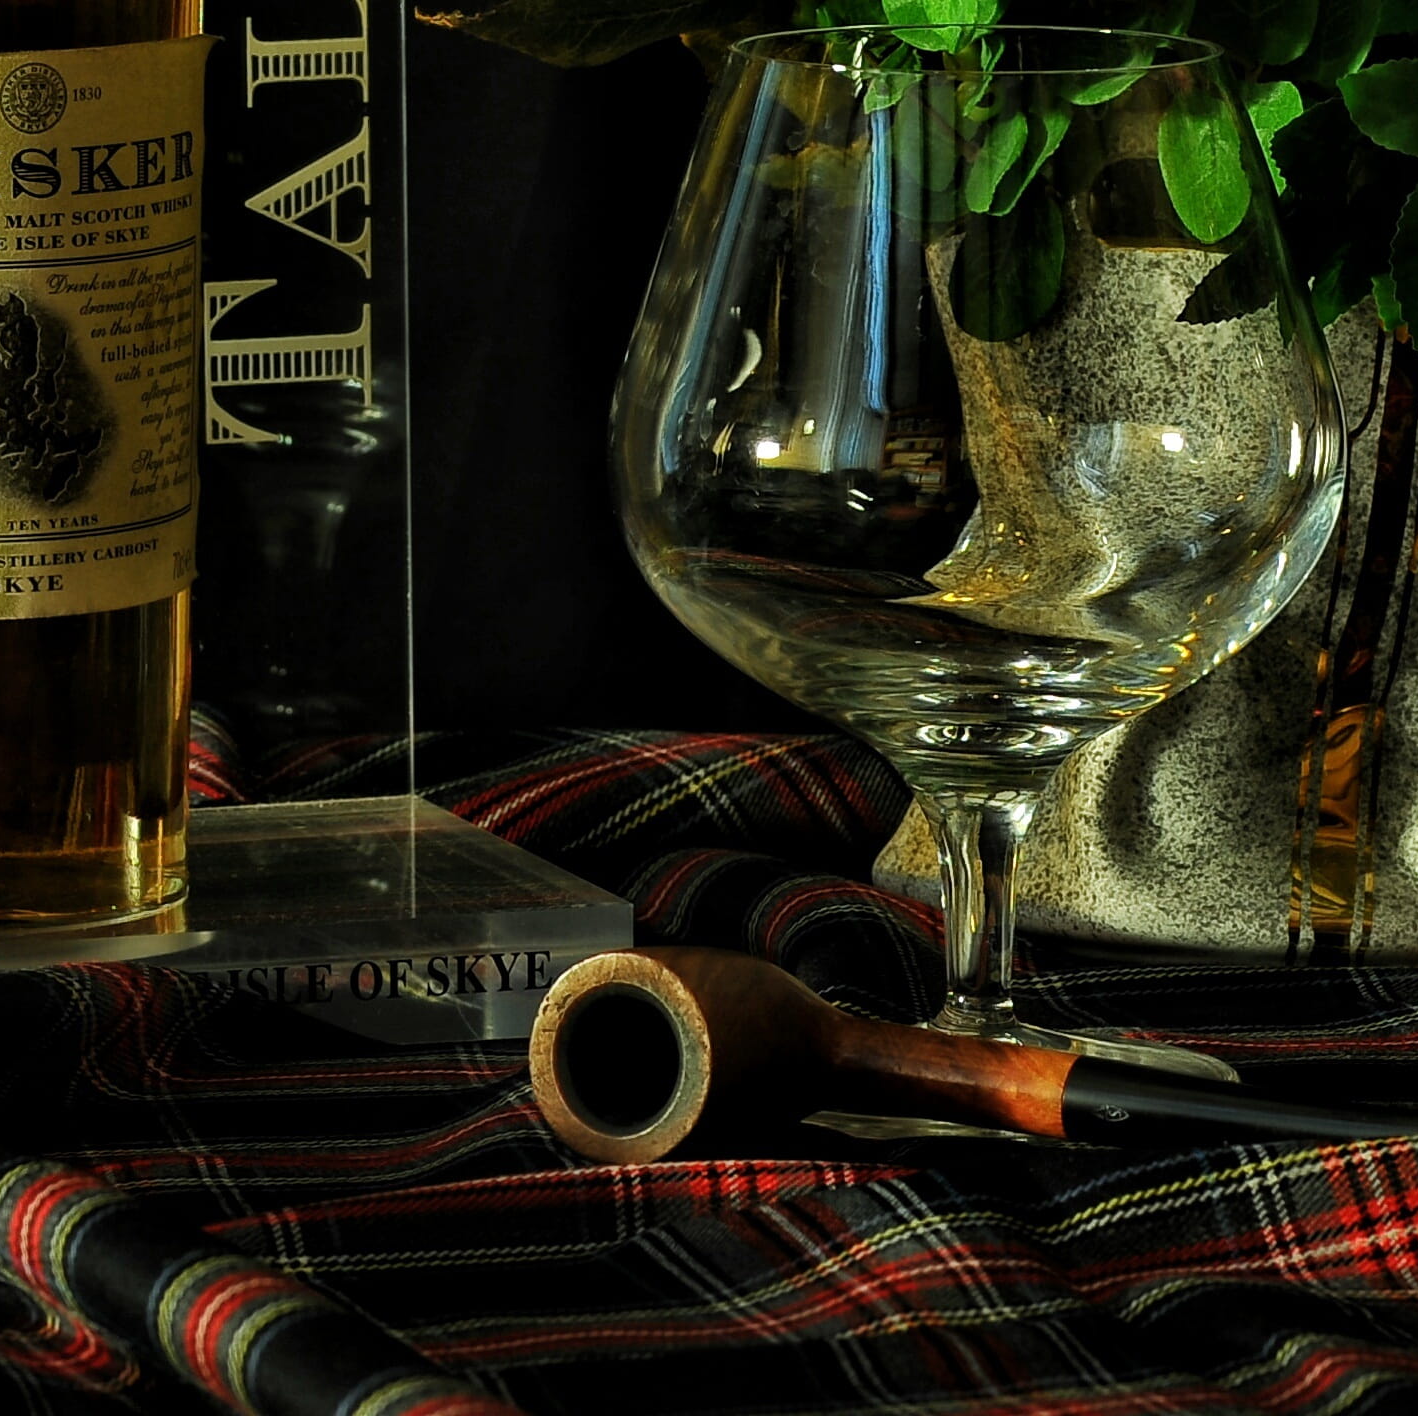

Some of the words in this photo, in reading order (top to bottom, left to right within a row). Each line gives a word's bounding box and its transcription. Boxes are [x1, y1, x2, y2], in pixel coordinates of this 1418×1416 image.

[73, 87, 102, 102] 1830
[4, 213, 66, 230] MALT
[70, 204, 146, 227] SCOTCH
[14, 235, 65, 251] ISLE
[70, 232, 101, 248] OF
[104, 225, 151, 245] SKYE
[46, 273, 100, 295] Drink
[101, 277, 117, 290] in
[117, 267, 139, 288] all
[137, 266, 154, 285] the
[78, 297, 125, 316] drama
[125, 289, 143, 318] of
[91, 326, 106, 339] in
[110, 316, 132, 336] this
[100, 335, 171, 363] full-bodied
[114, 361, 141, 382] with
[147, 367, 155, 377] a
[7, 519, 41, 532] TEN
[48, 514, 100, 529] YEARS
[92, 538, 160, 562] CARBOST
[228, 964, 334, 1005] ISLE
[349, 958, 415, 1002] OF
[426, 950, 555, 997] SKYE
